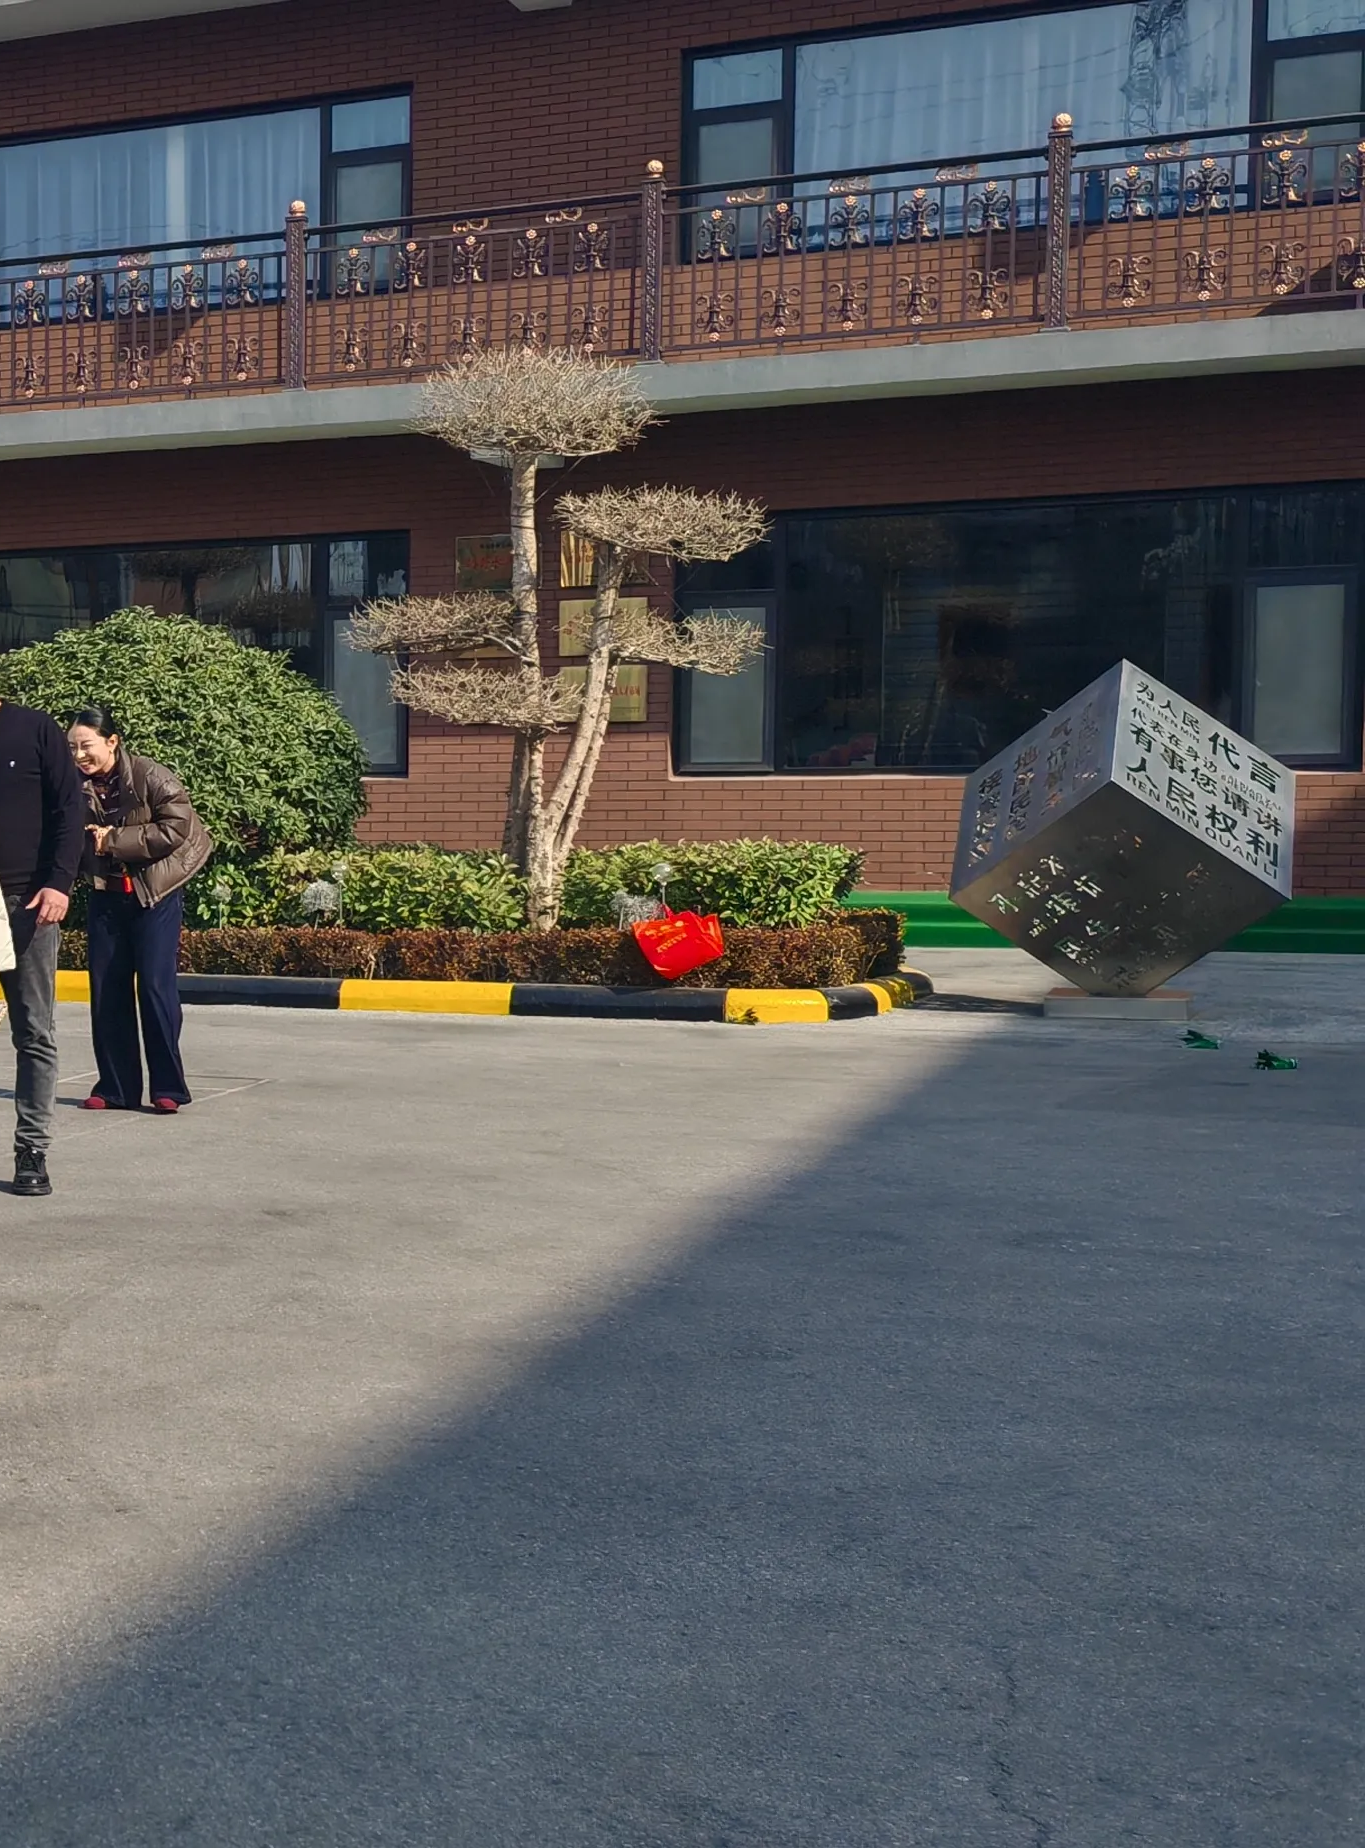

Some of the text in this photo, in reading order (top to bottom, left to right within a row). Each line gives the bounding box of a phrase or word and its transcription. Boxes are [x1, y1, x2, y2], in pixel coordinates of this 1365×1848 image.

[1130, 722, 1283, 837] 有事您请讲
[1131, 707, 1218, 773] 代表在身边
[1126, 756, 1279, 867] 人民权利
[1126, 772, 1277, 879] REN MIN QUAN LI
